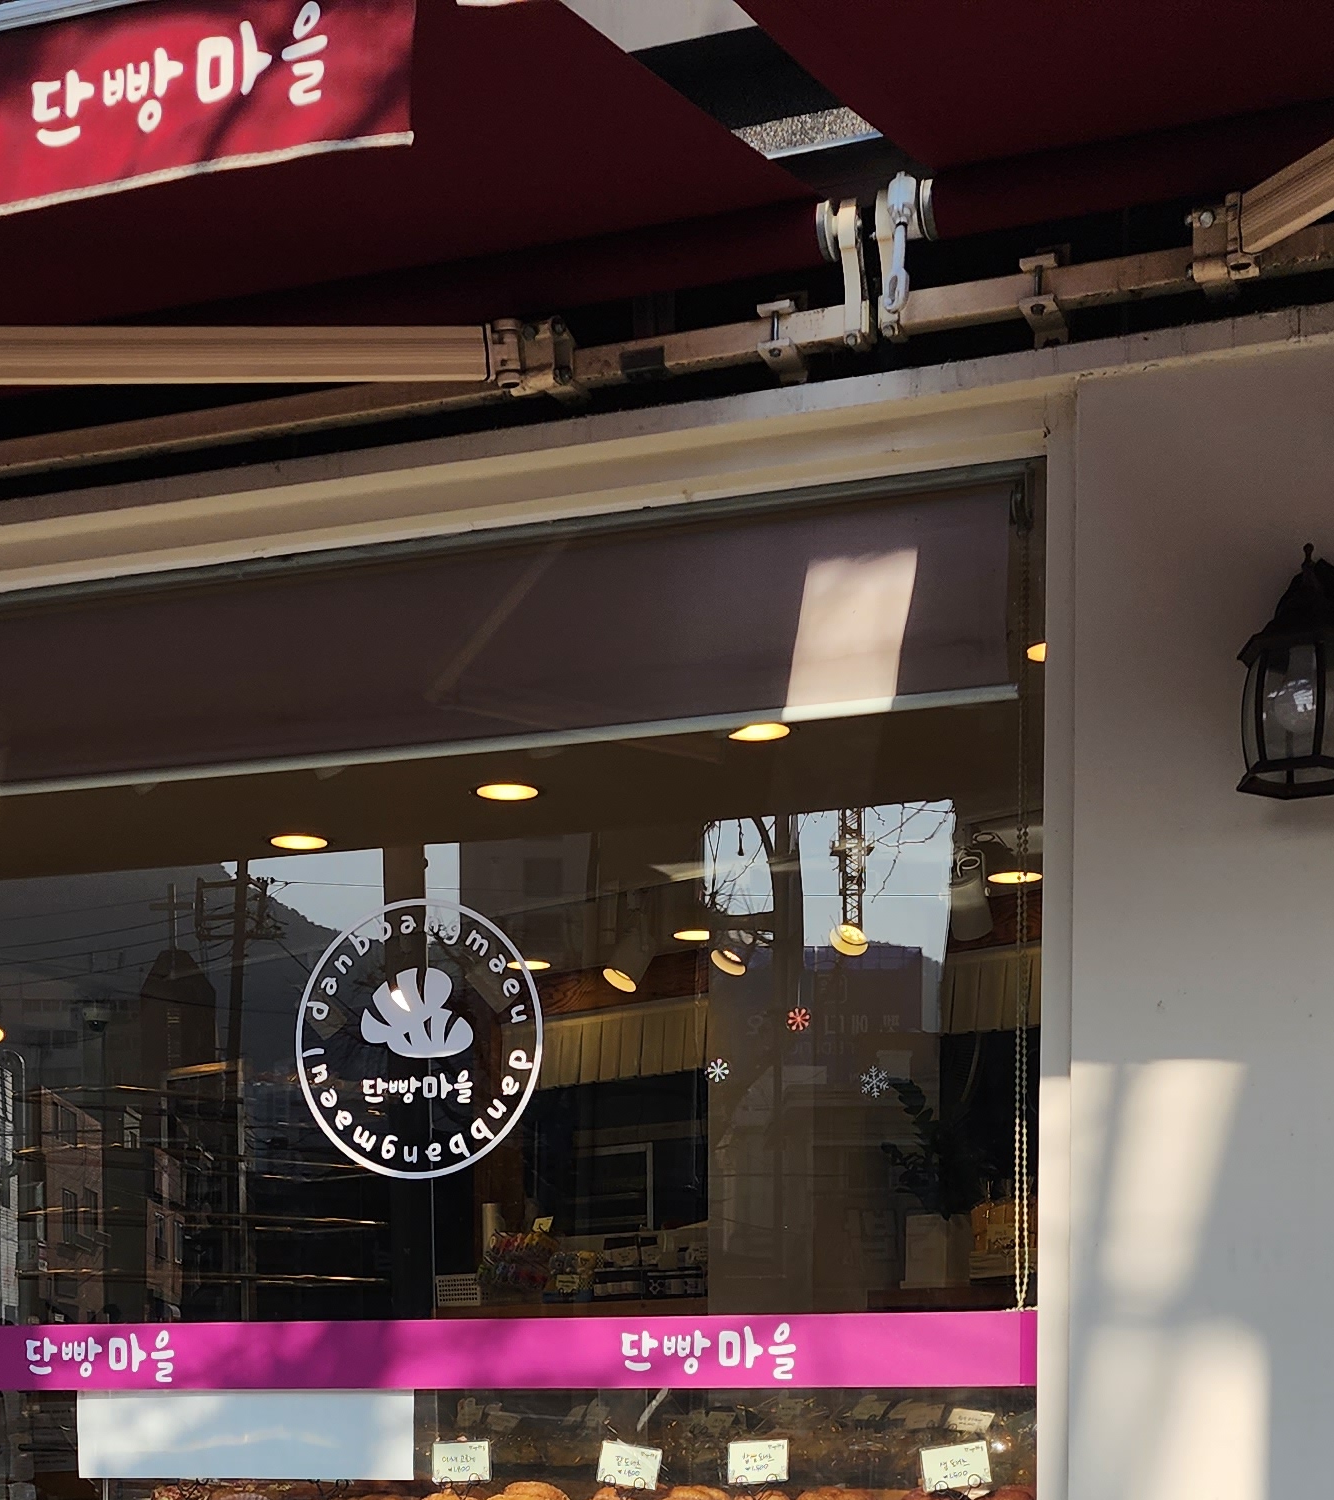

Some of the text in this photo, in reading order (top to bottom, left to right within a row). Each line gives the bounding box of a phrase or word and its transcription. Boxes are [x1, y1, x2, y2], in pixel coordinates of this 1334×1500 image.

[31, 1, 329, 147] 단빵마을
[362, 1069, 474, 1104] 단빵마을
[25, 1330, 176, 1384] 단빵마을
[620, 1322, 797, 1381] 단빵마을
